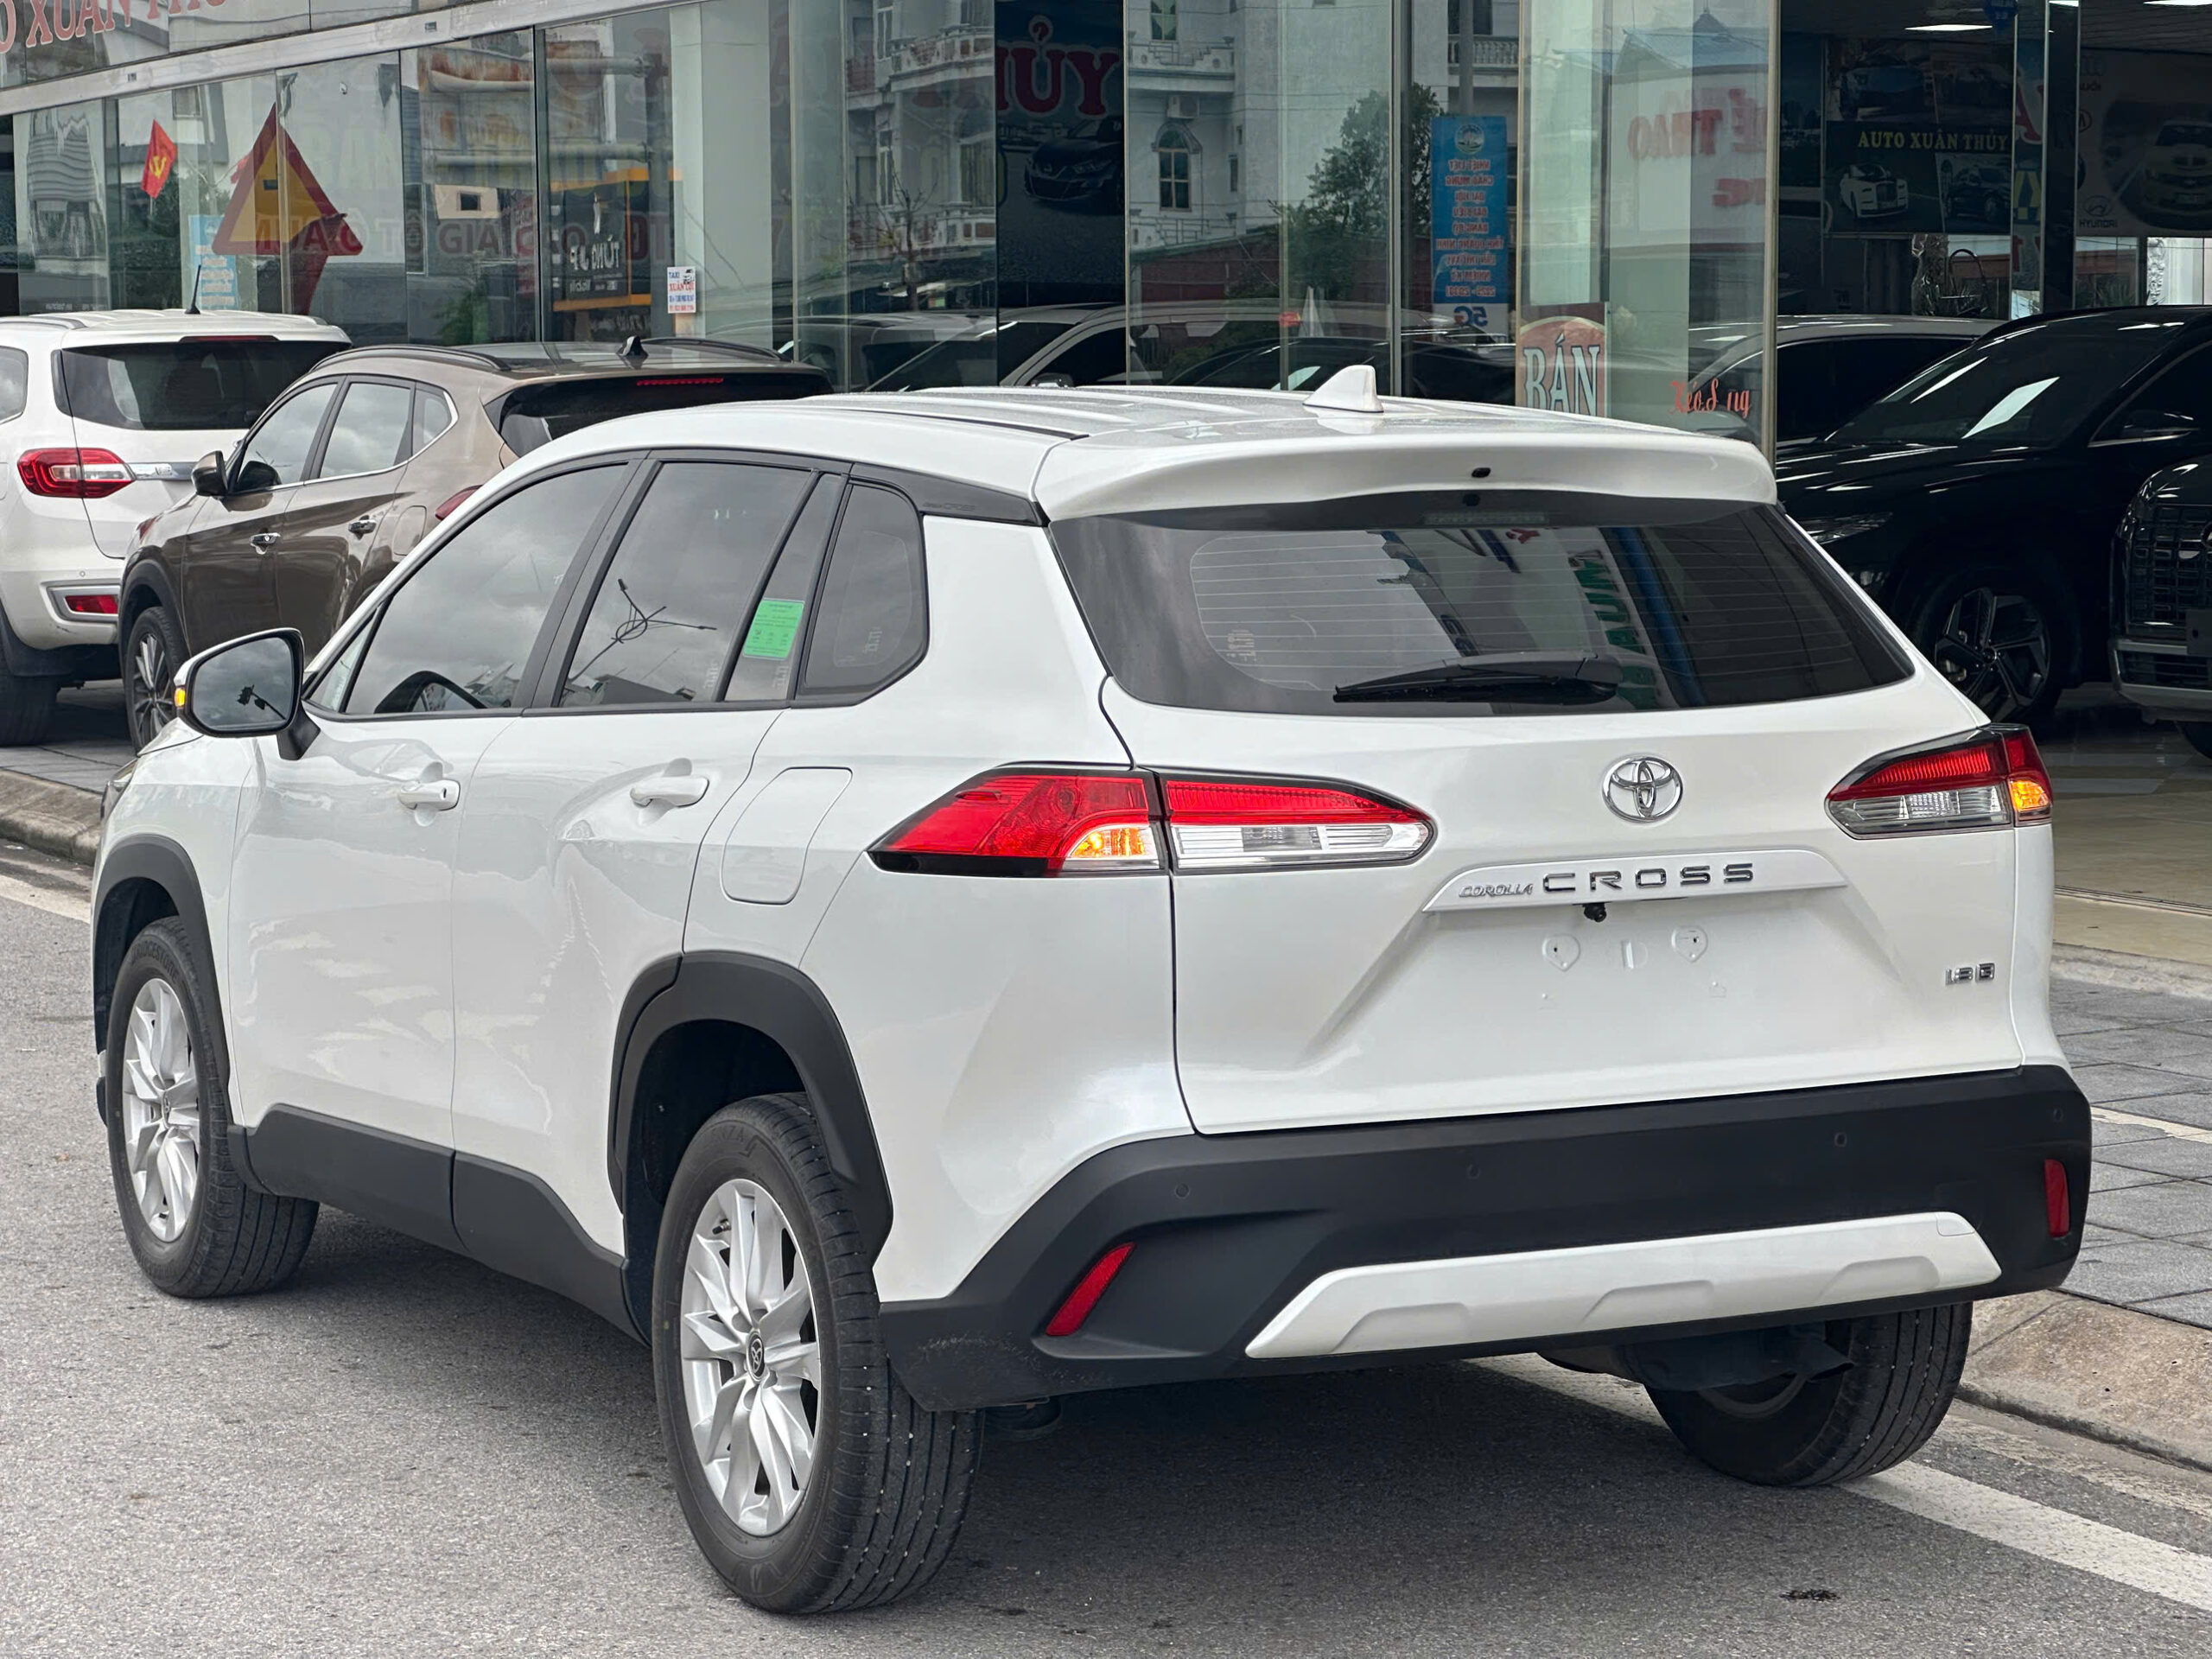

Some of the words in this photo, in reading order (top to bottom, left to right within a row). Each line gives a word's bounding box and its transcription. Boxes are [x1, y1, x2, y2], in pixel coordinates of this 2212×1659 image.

[1858, 130, 1905, 149] AUTO
[1910, 128, 1958, 150] XUÂN
[1962, 129, 2008, 151] THỦY
[1522, 332, 1601, 417] BÁN
[1459, 882, 1535, 899] COROLLA
[1541, 861, 1754, 893] CROSS
